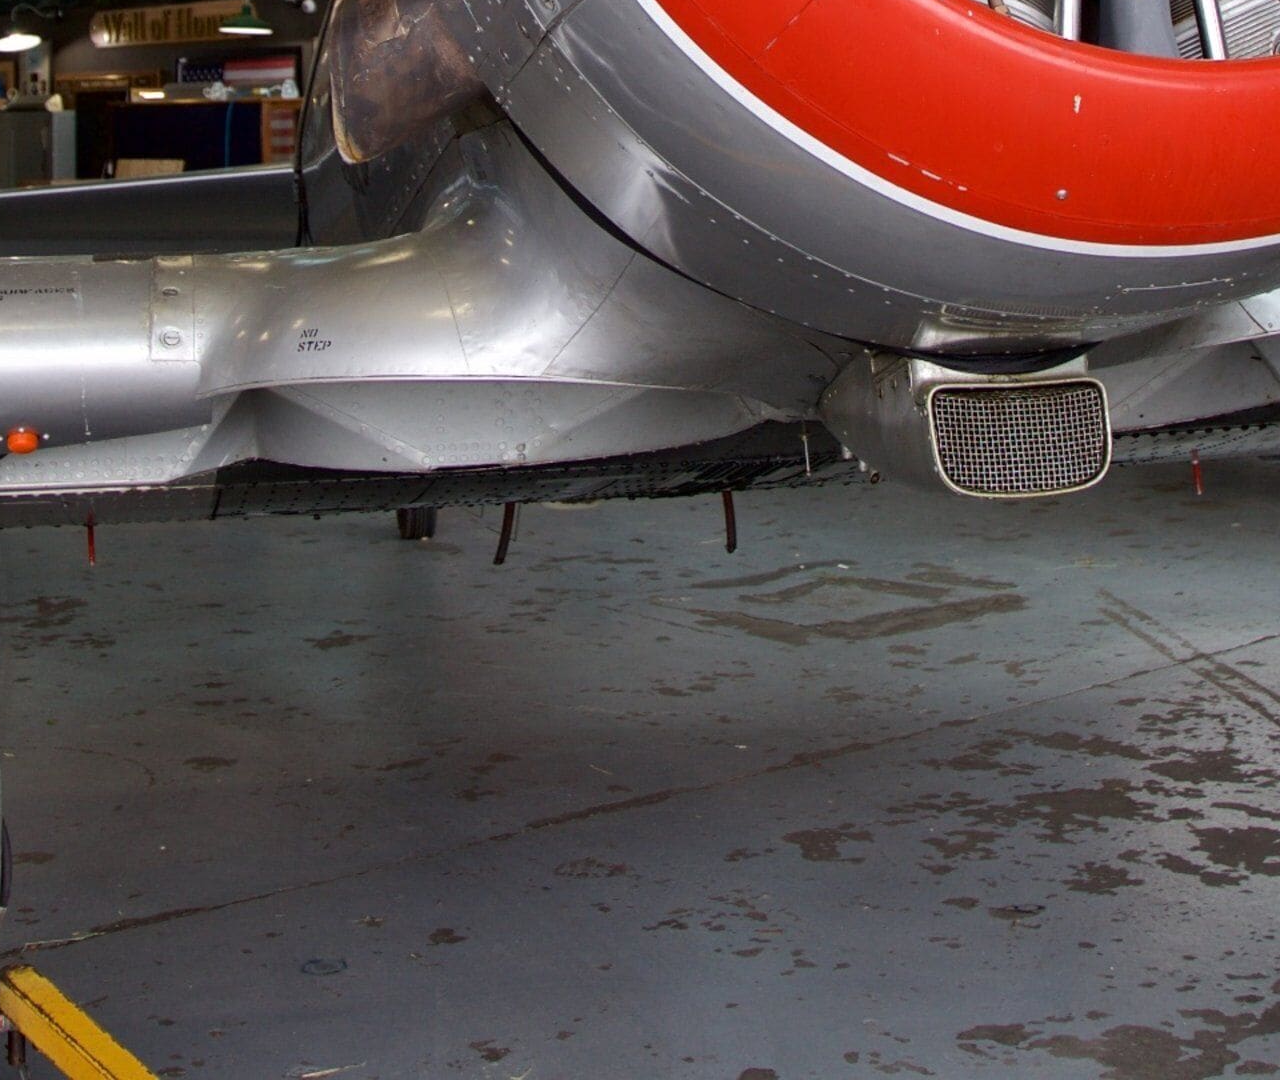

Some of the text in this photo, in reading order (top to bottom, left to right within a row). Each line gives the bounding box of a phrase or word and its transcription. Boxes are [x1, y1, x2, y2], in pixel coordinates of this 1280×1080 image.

[103, 10, 146, 44] Wall
[151, 9, 169, 40] of
[297, 340, 332, 352] STEP
